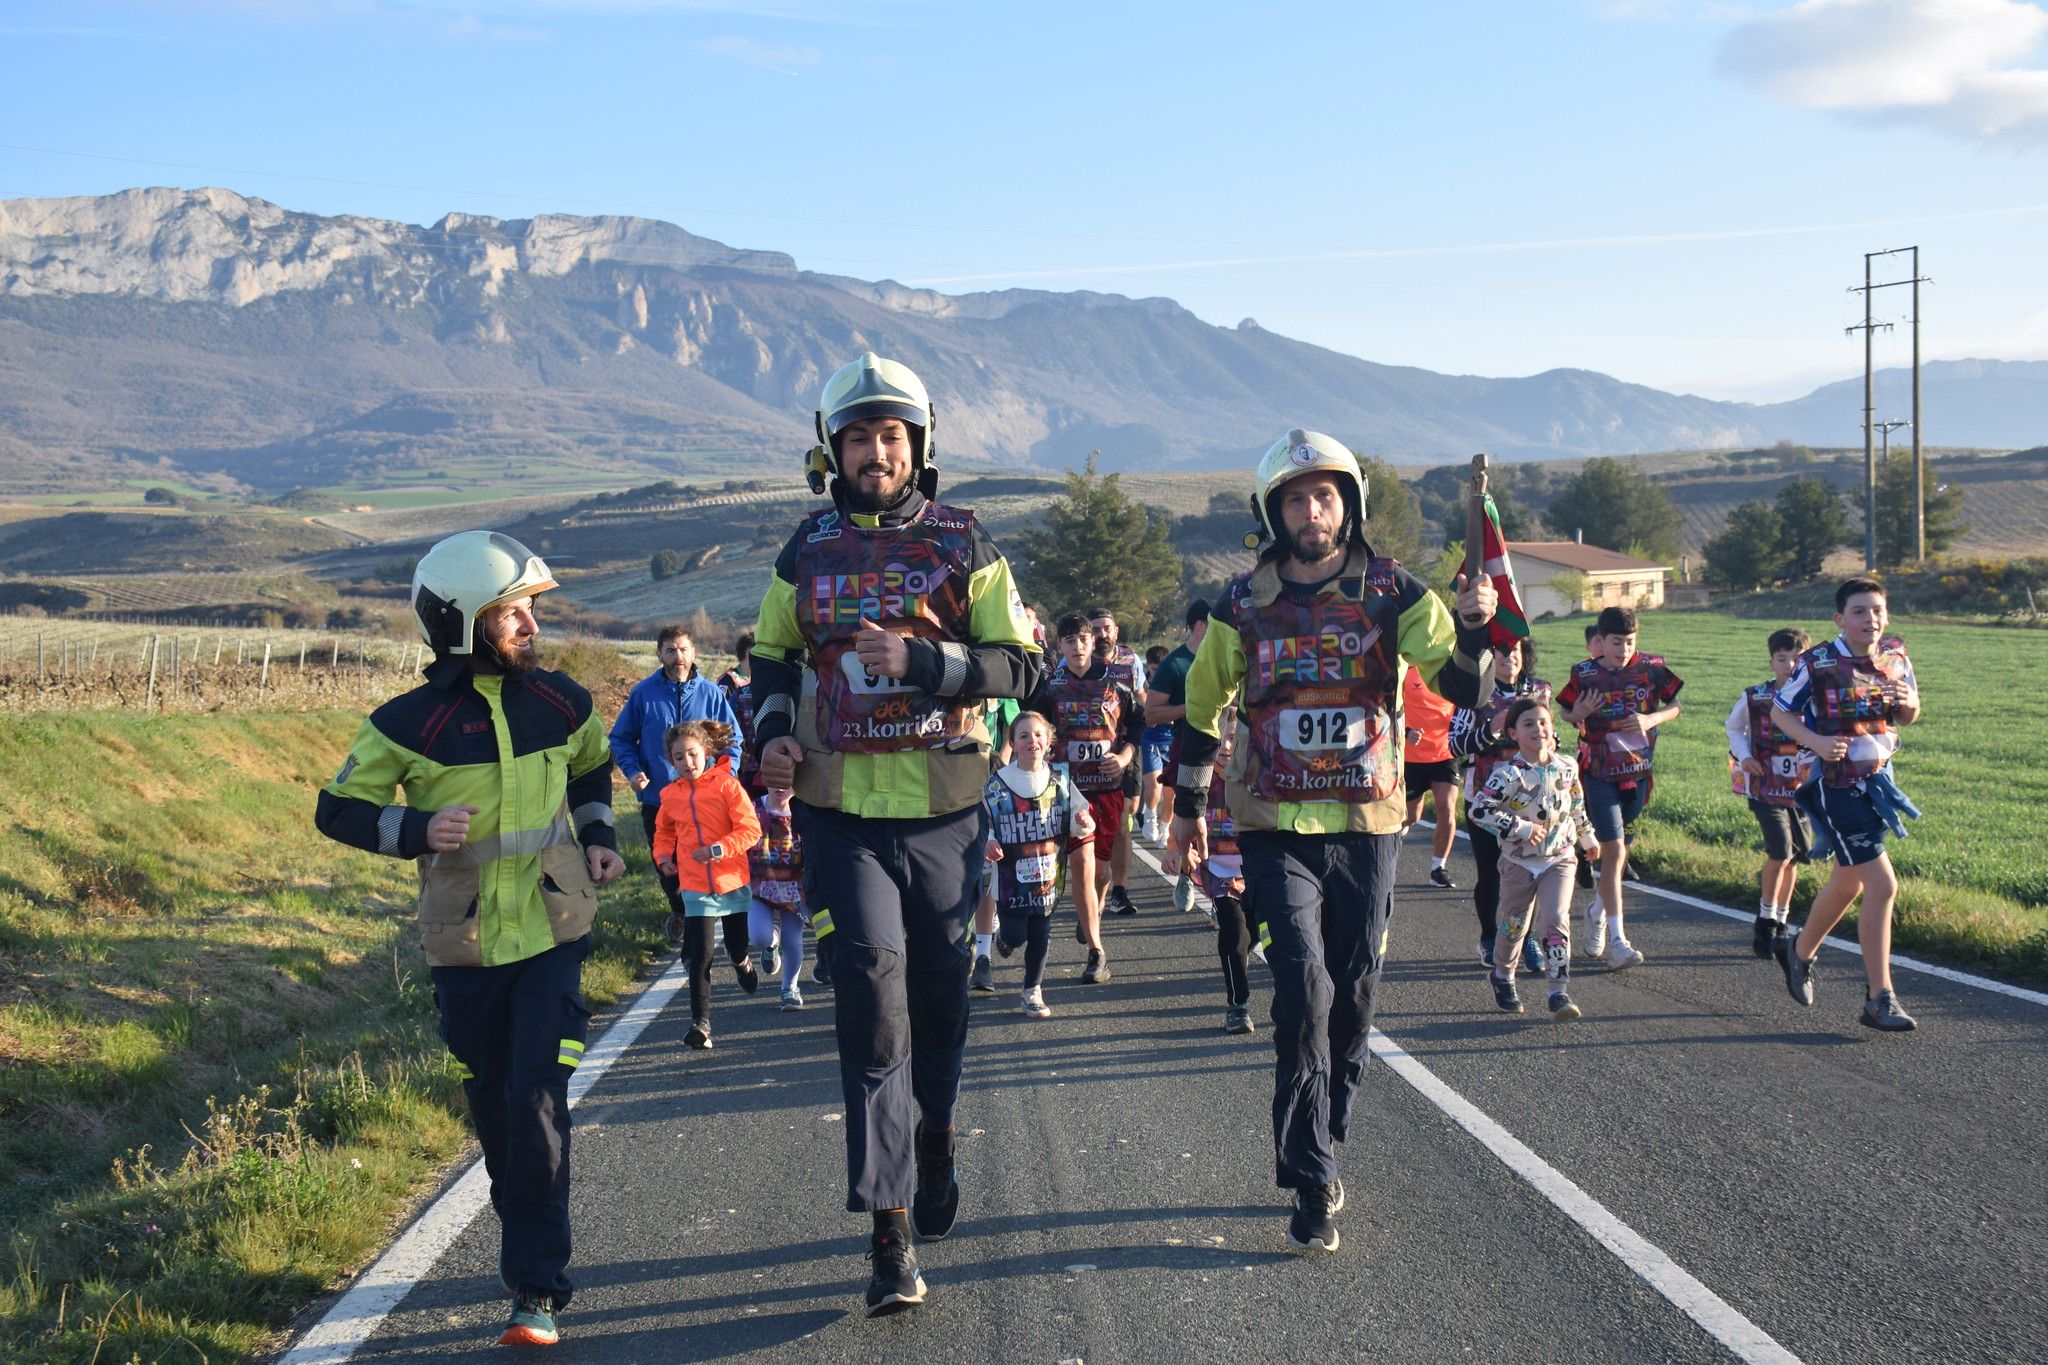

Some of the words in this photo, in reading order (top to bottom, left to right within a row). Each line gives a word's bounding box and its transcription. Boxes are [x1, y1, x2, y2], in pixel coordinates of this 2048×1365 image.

[938, 520, 965, 529] eitb
[1366, 576, 1391, 587] eitb
[874, 695, 912, 719] aek
[1298, 711, 1348, 745] 912
[1078, 743, 1103, 760] 910
